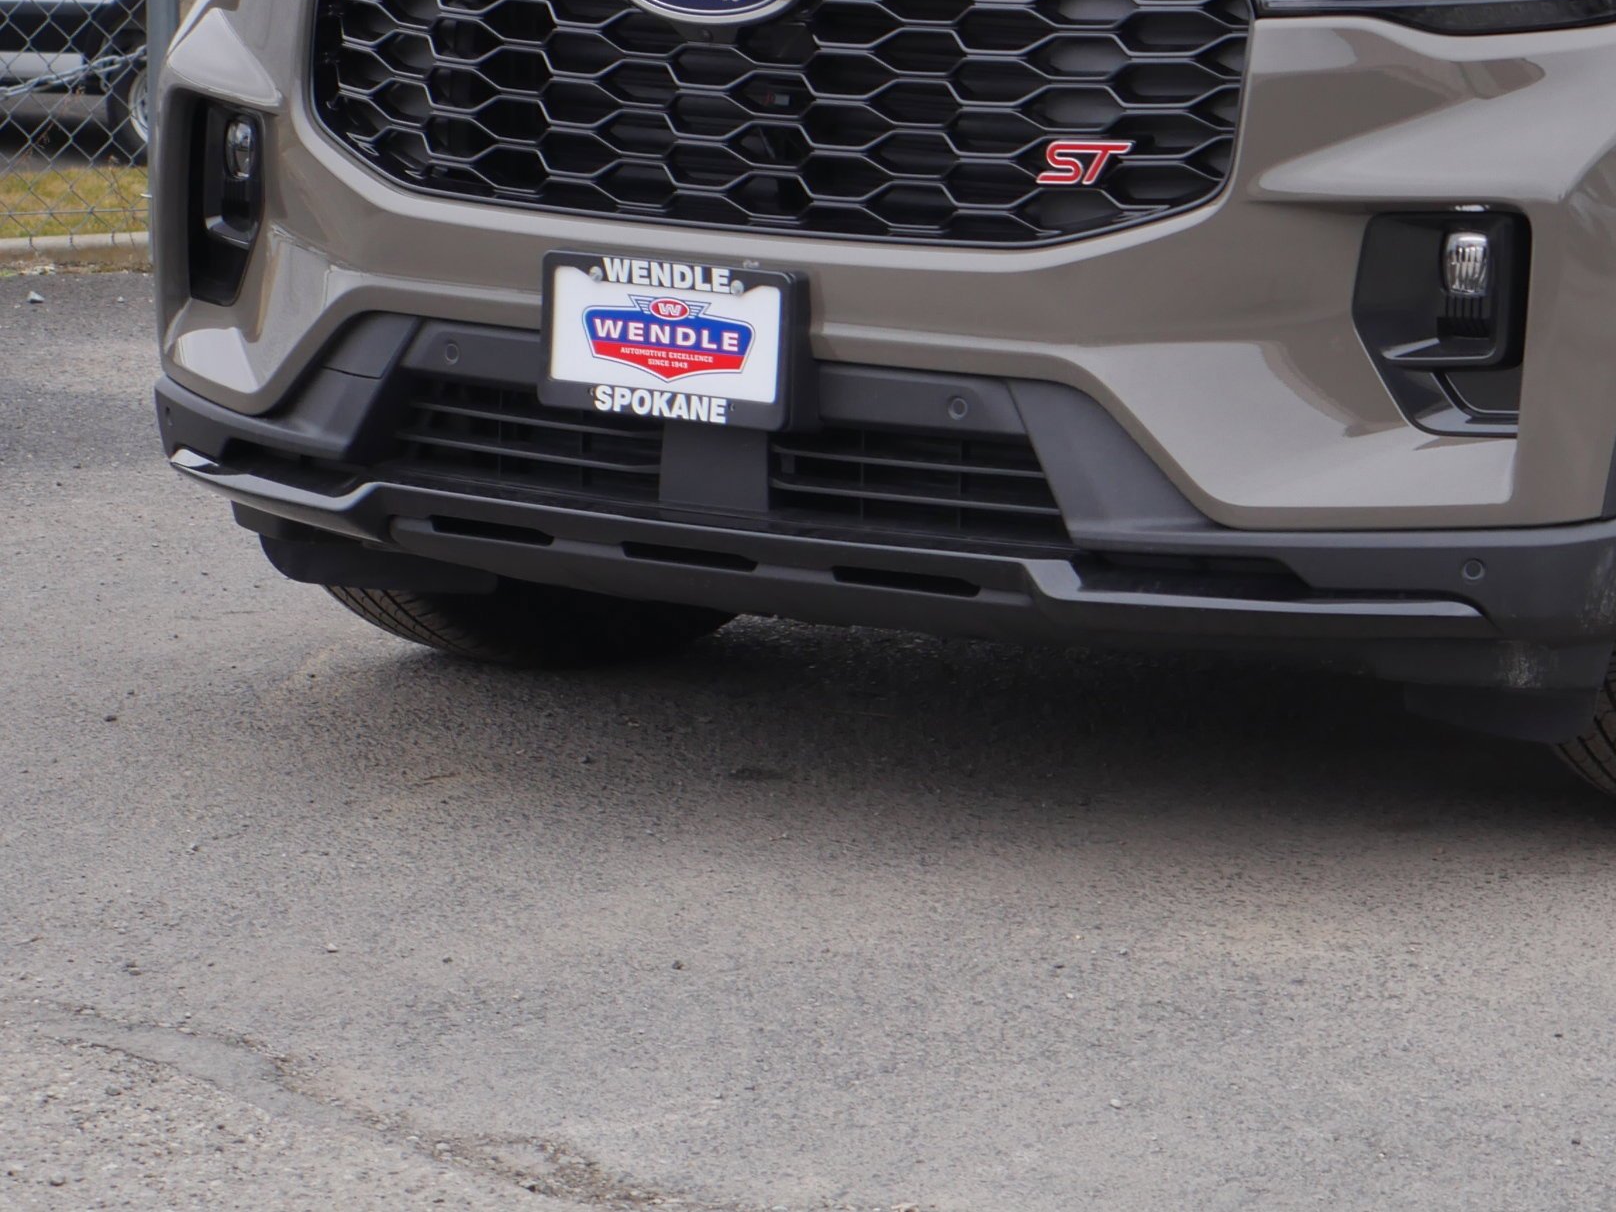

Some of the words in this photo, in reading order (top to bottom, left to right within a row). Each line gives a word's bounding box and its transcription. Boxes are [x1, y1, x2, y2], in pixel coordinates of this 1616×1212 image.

[1036, 140, 1132, 184] ST
[602, 257, 731, 295] WENDLE
[593, 318, 739, 352] WENDLE
[620, 347, 667, 359] AUTOMOTIVE
[668, 351, 713, 363] EXCELLENCE
[648, 358, 669, 367] SINCE
[671, 361, 688, 369] 1943
[593, 385, 727, 424] SPOKANE
